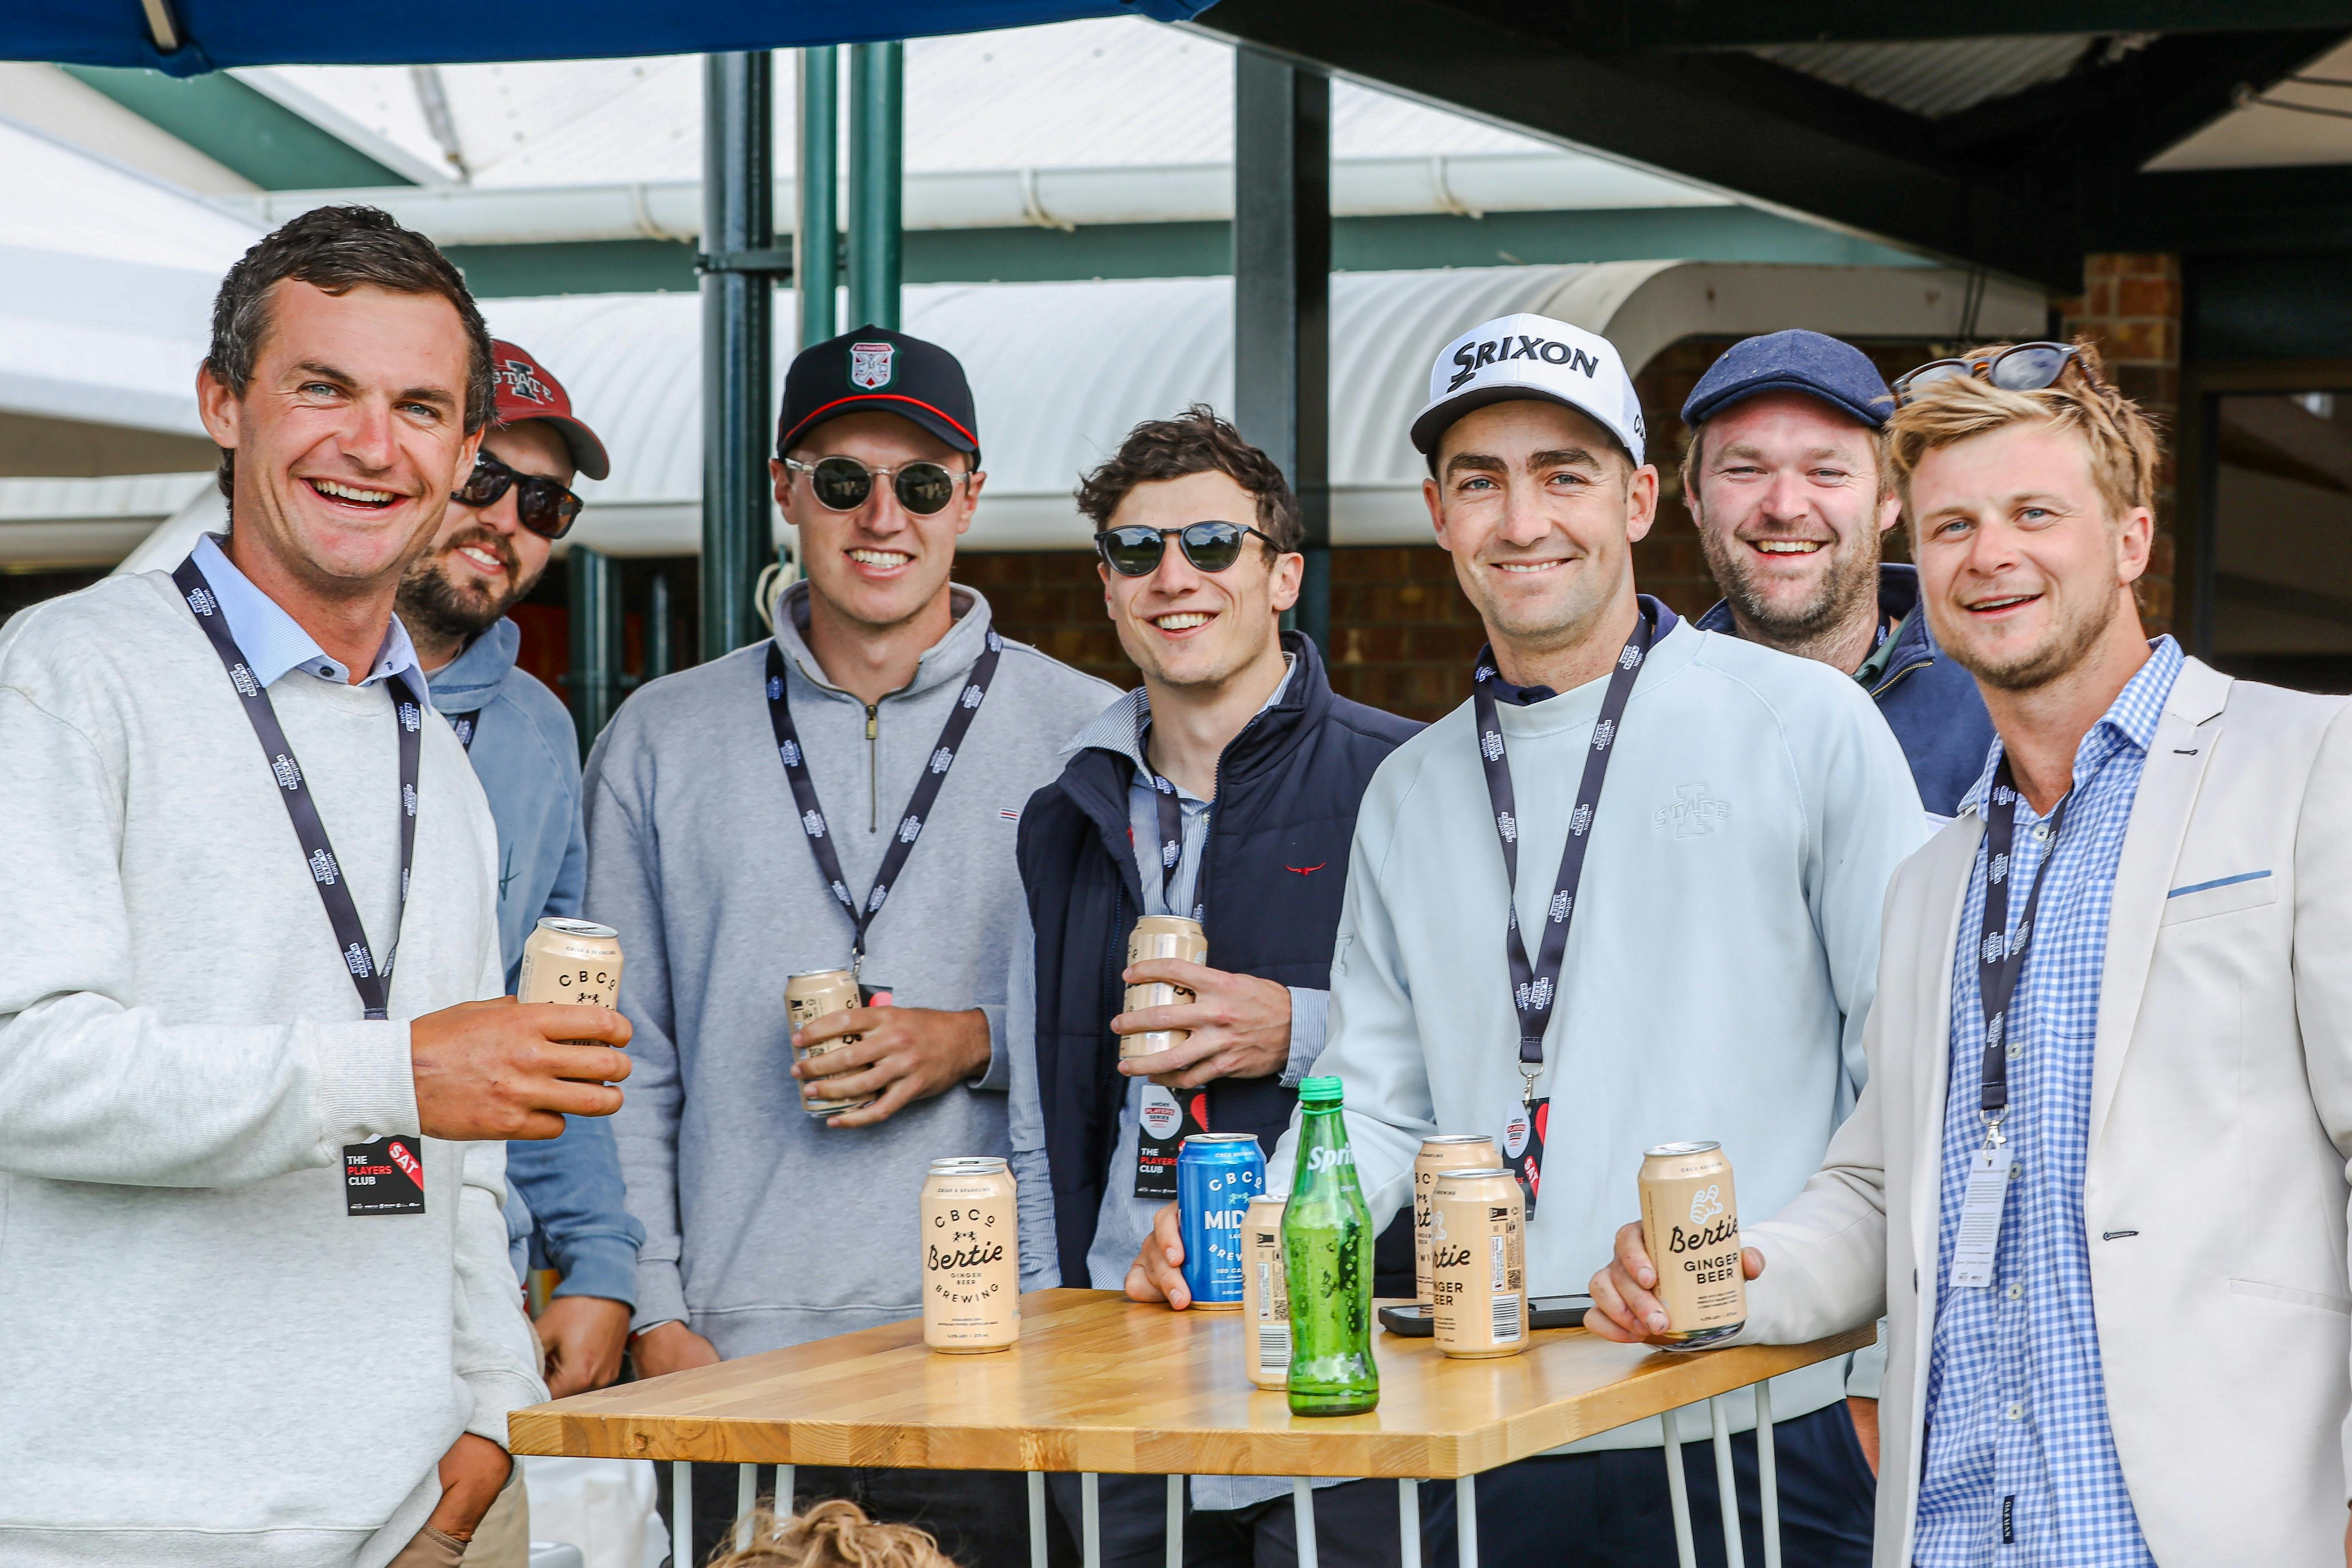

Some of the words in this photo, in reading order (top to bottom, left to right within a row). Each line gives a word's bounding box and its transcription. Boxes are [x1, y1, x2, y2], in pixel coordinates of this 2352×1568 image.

[1447, 335, 1599, 393] SRIXON
[492, 372, 554, 401] STATE
[1486, 731, 1499, 761] PLAYERS
[1596, 719, 1612, 751] PLAYERS
[1575, 803, 1589, 836] PLAYERS
[1654, 800, 1730, 830] STATE
[1555, 890, 1568, 923] PLAYERS
[1535, 977, 1548, 1010] PLAYERS
[346, 1155, 368, 1165] THE
[347, 1166, 393, 1175] PLAYERS
[390, 1145, 419, 1174] SAT
[1139, 1165, 1163, 1174] CLUB
[1140, 1157, 1178, 1165] PLAYERS
[1307, 1142, 1353, 1173] Spri
[1524, 1158, 1539, 1184] SAT
[348, 1176, 377, 1186] CLUB
[1669, 1214, 1738, 1253] Bertie
[928, 1241, 1003, 1271] Bertie
[1433, 1244, 1471, 1269] rtie
[1684, 1252, 1739, 1272] GINGER
[1697, 1269, 1734, 1285] BEER
[936, 1283, 998, 1303] BREWING
[1434, 1294, 1454, 1306] EER
